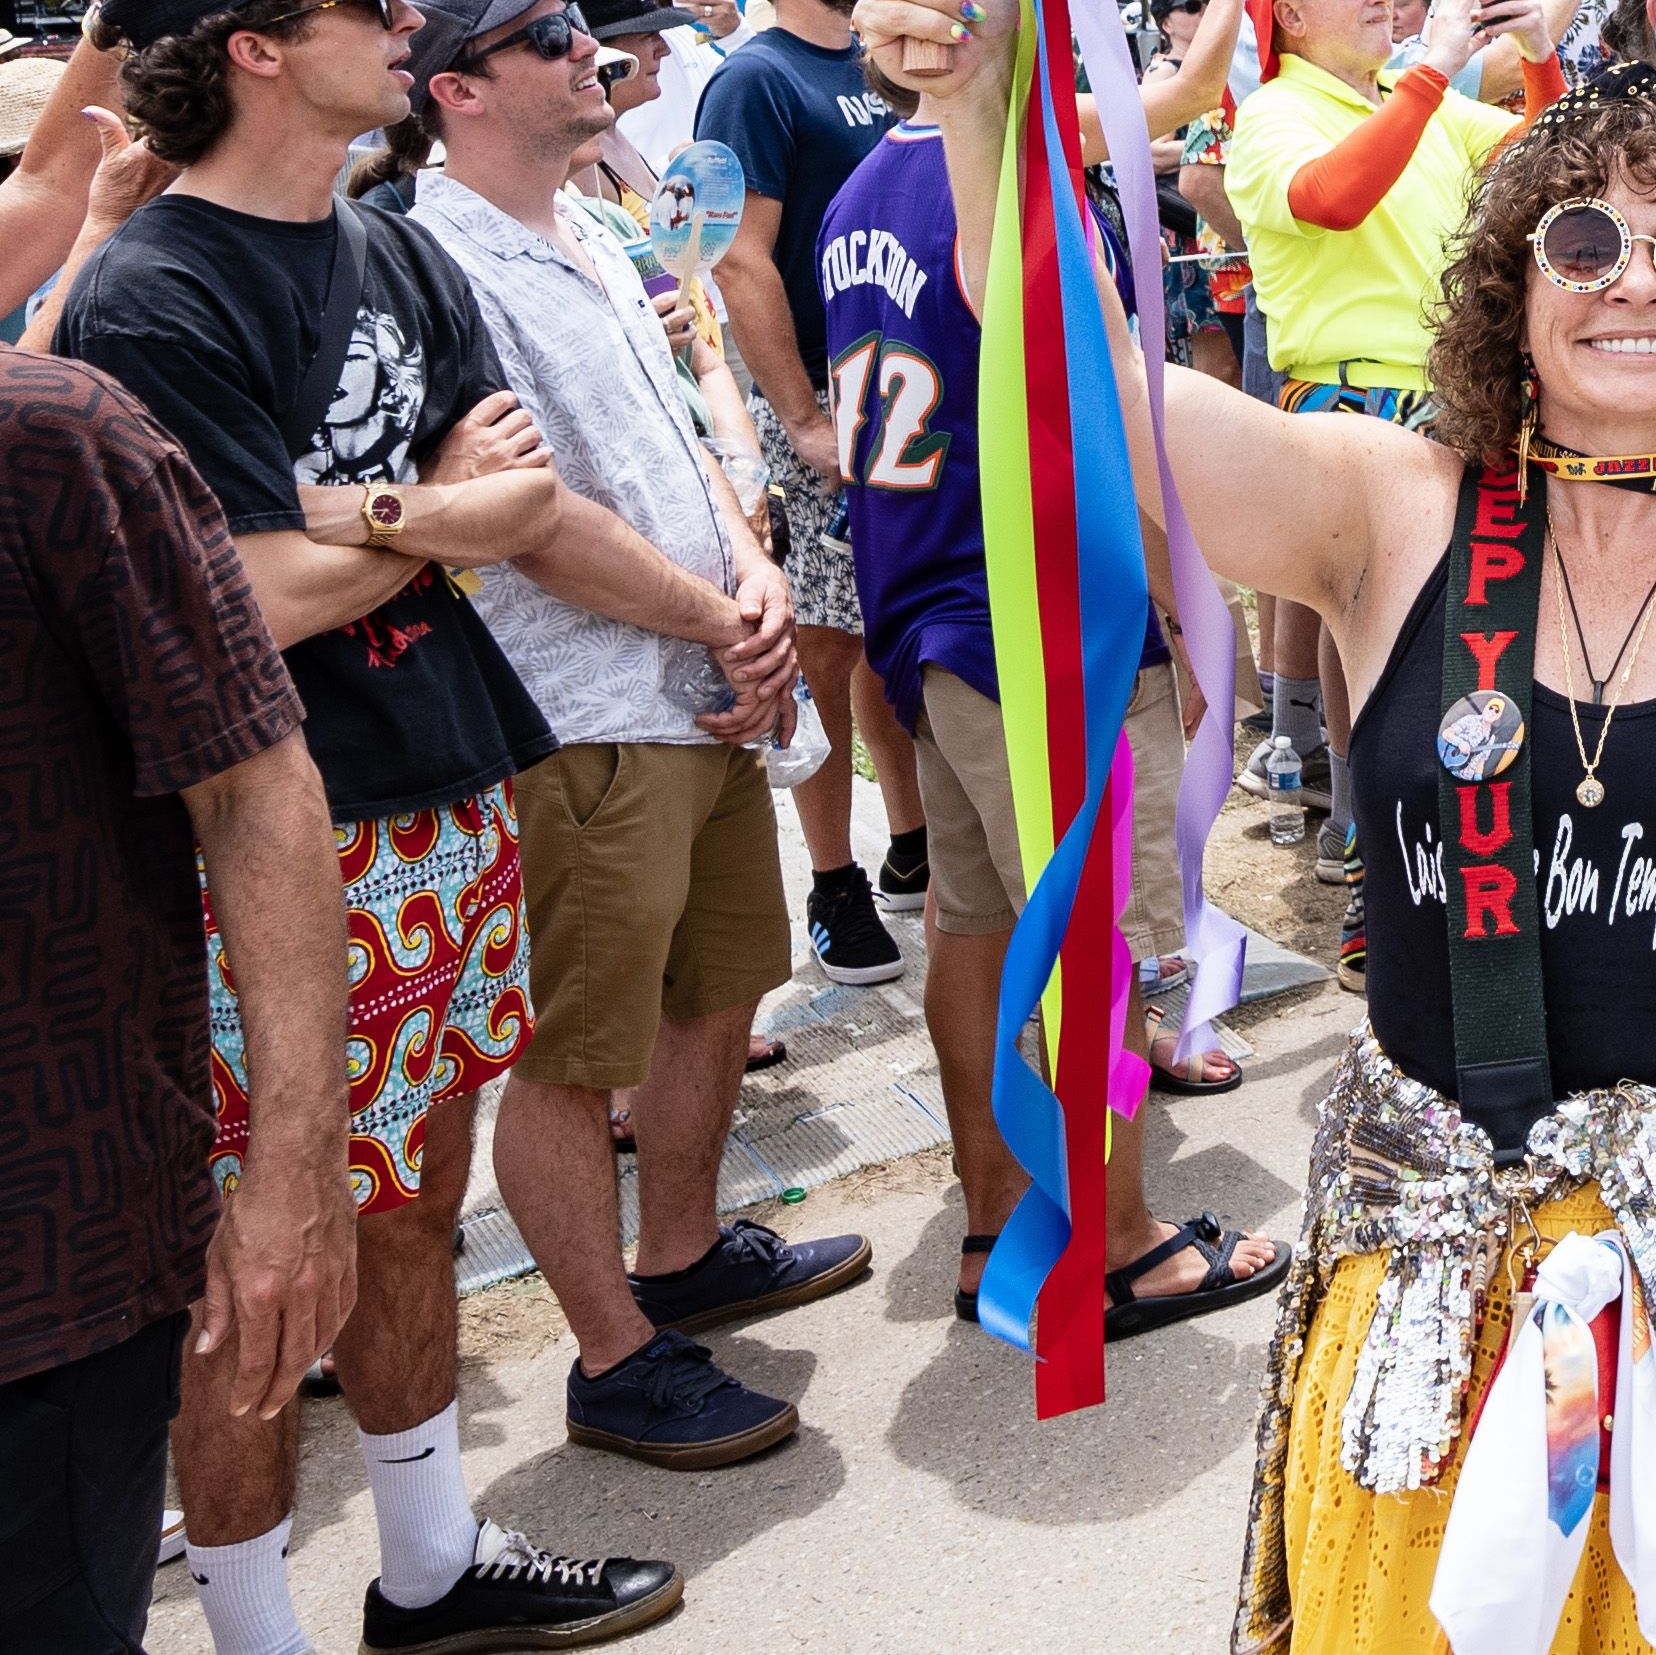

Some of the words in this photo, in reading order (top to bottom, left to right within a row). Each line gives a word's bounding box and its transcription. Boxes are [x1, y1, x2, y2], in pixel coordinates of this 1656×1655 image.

[836, 92, 894, 128] NAS
[821, 227, 928, 321] TOCKTON
[833, 334, 946, 491] 12
[1545, 813, 1601, 930] Bon
